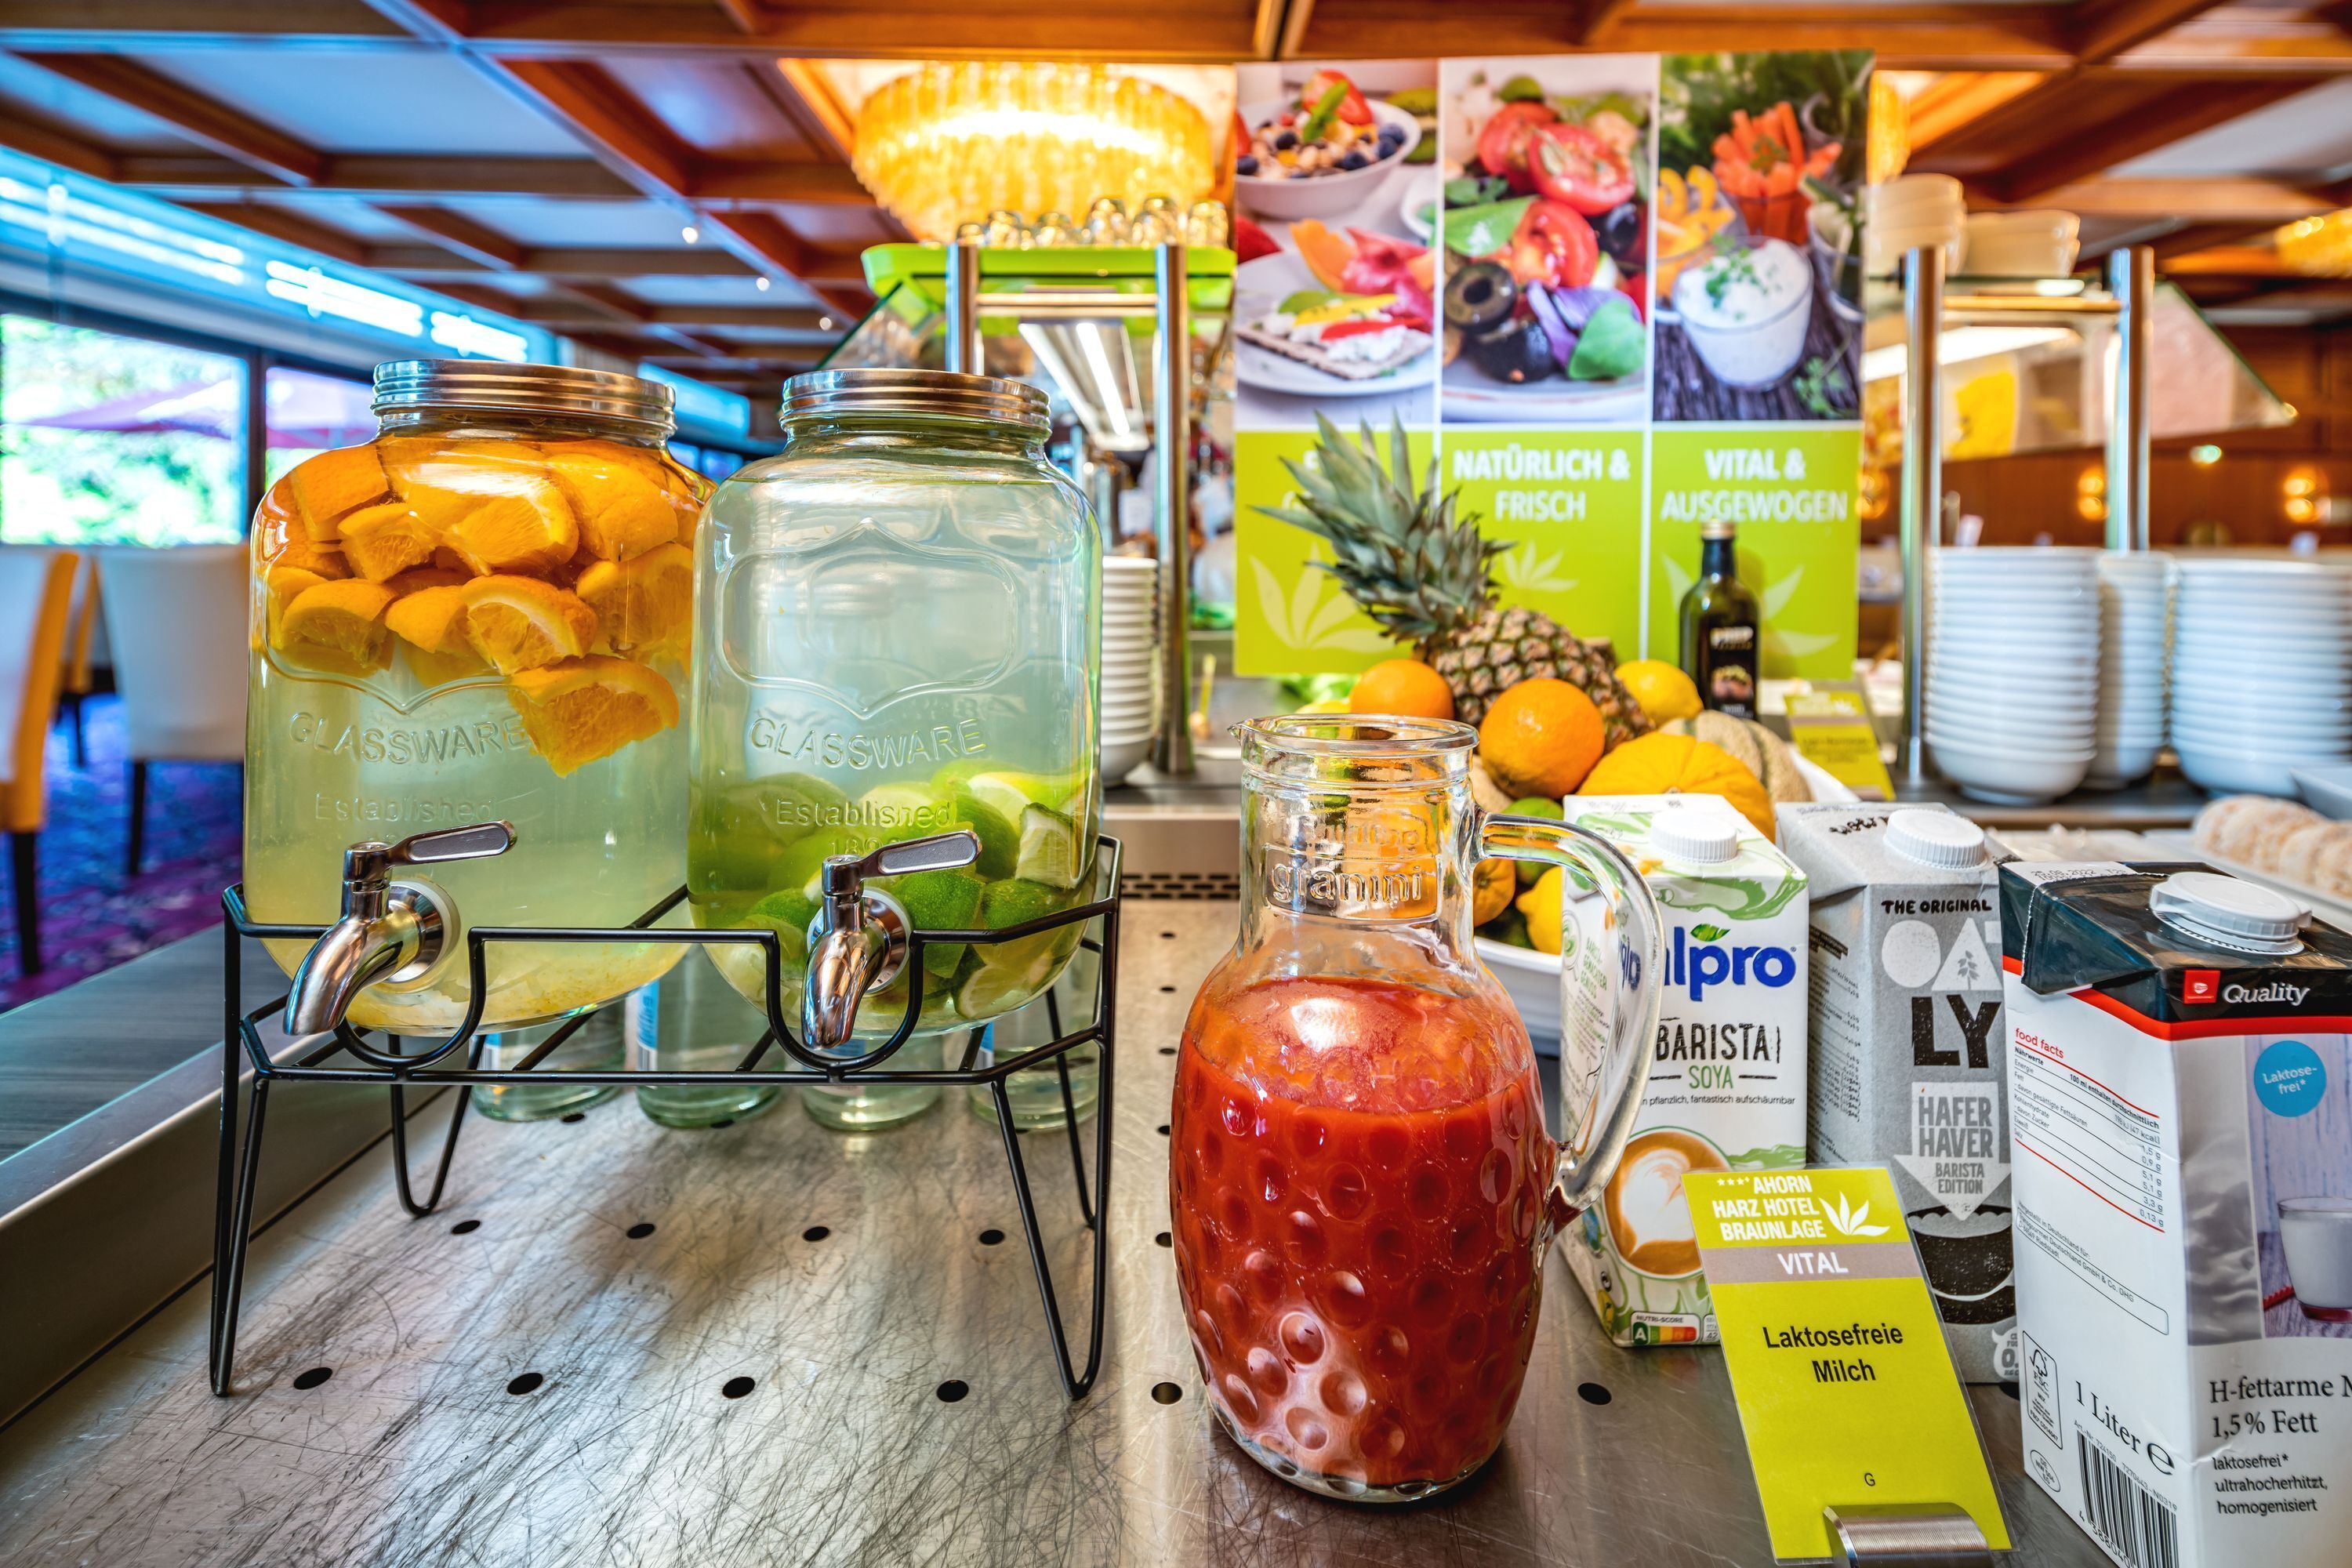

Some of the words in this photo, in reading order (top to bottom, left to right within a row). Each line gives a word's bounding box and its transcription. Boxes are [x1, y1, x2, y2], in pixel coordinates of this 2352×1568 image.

[1453, 443, 1602, 481] NATÜRLICH
[1608, 448, 1631, 481] &
[1704, 448, 1780, 481] VITAL
[1783, 448, 1806, 481] &
[1495, 490, 1586, 522] FRISCH
[1660, 490, 1848, 523] AUSGEWOGEN
[289, 712, 531, 765] GLASSWARE
[750, 717, 988, 770] GLASSWARE
[776, 797, 957, 828] Established
[1272, 863, 1422, 902] granini
[1882, 900, 1916, 914] THE
[1921, 898, 1992, 913] ORIGINAL
[1664, 927, 1796, 1002] lpro
[2222, 982, 2310, 1006] Quality
[1656, 1023, 1771, 1062] BARISTA
[1911, 994, 2002, 1069] LY
[2016, 1028, 2038, 1046] food
[2040, 1039, 2064, 1058] facts
[2015, 1047, 2044, 1065] Nährwerte
[1689, 1065, 1734, 1089] SOYA
[2263, 1066, 2317, 1084] Laktose-
[1650, 1094, 1690, 1106] pflanzlich,
[1690, 1094, 1733, 1105] fantastisch
[1736, 1094, 1795, 1105] aufschäumbar
[1918, 1096, 1992, 1127] HAFER
[1919, 1127, 1993, 1158] HAVER
[1936, 1163, 1984, 1178] BARISTA
[1753, 1175, 1813, 1194] AHORN
[1938, 1179, 1983, 1194] EDITION
[1712, 1200, 1762, 1218] HARZ
[1766, 1197, 1820, 1216] HOTEL
[1720, 1220, 1827, 1241] BRAUNLAGE
[1777, 1252, 1849, 1275] VITAL
[2082, 1262, 2100, 1279] GmbH
[2107, 1279, 2118, 1292] Co.
[2119, 1287, 2134, 1302] OHG
[1634, 1327, 1647, 1341] A
[1762, 1323, 1904, 1348] Laktosefreie
[1812, 1359, 1876, 1383] Milch
[2209, 1375, 2334, 1403] H-fettarme
[2076, 1381, 2085, 1406] 1
[2091, 1392, 2141, 1455] Liter
[2272, 1410, 2319, 1434] Fett
[1864, 1472, 1876, 1486] G
[2216, 1475, 2328, 1493] ultrahocherhitzt,
[2217, 1498, 2318, 1517] homogenisiert
